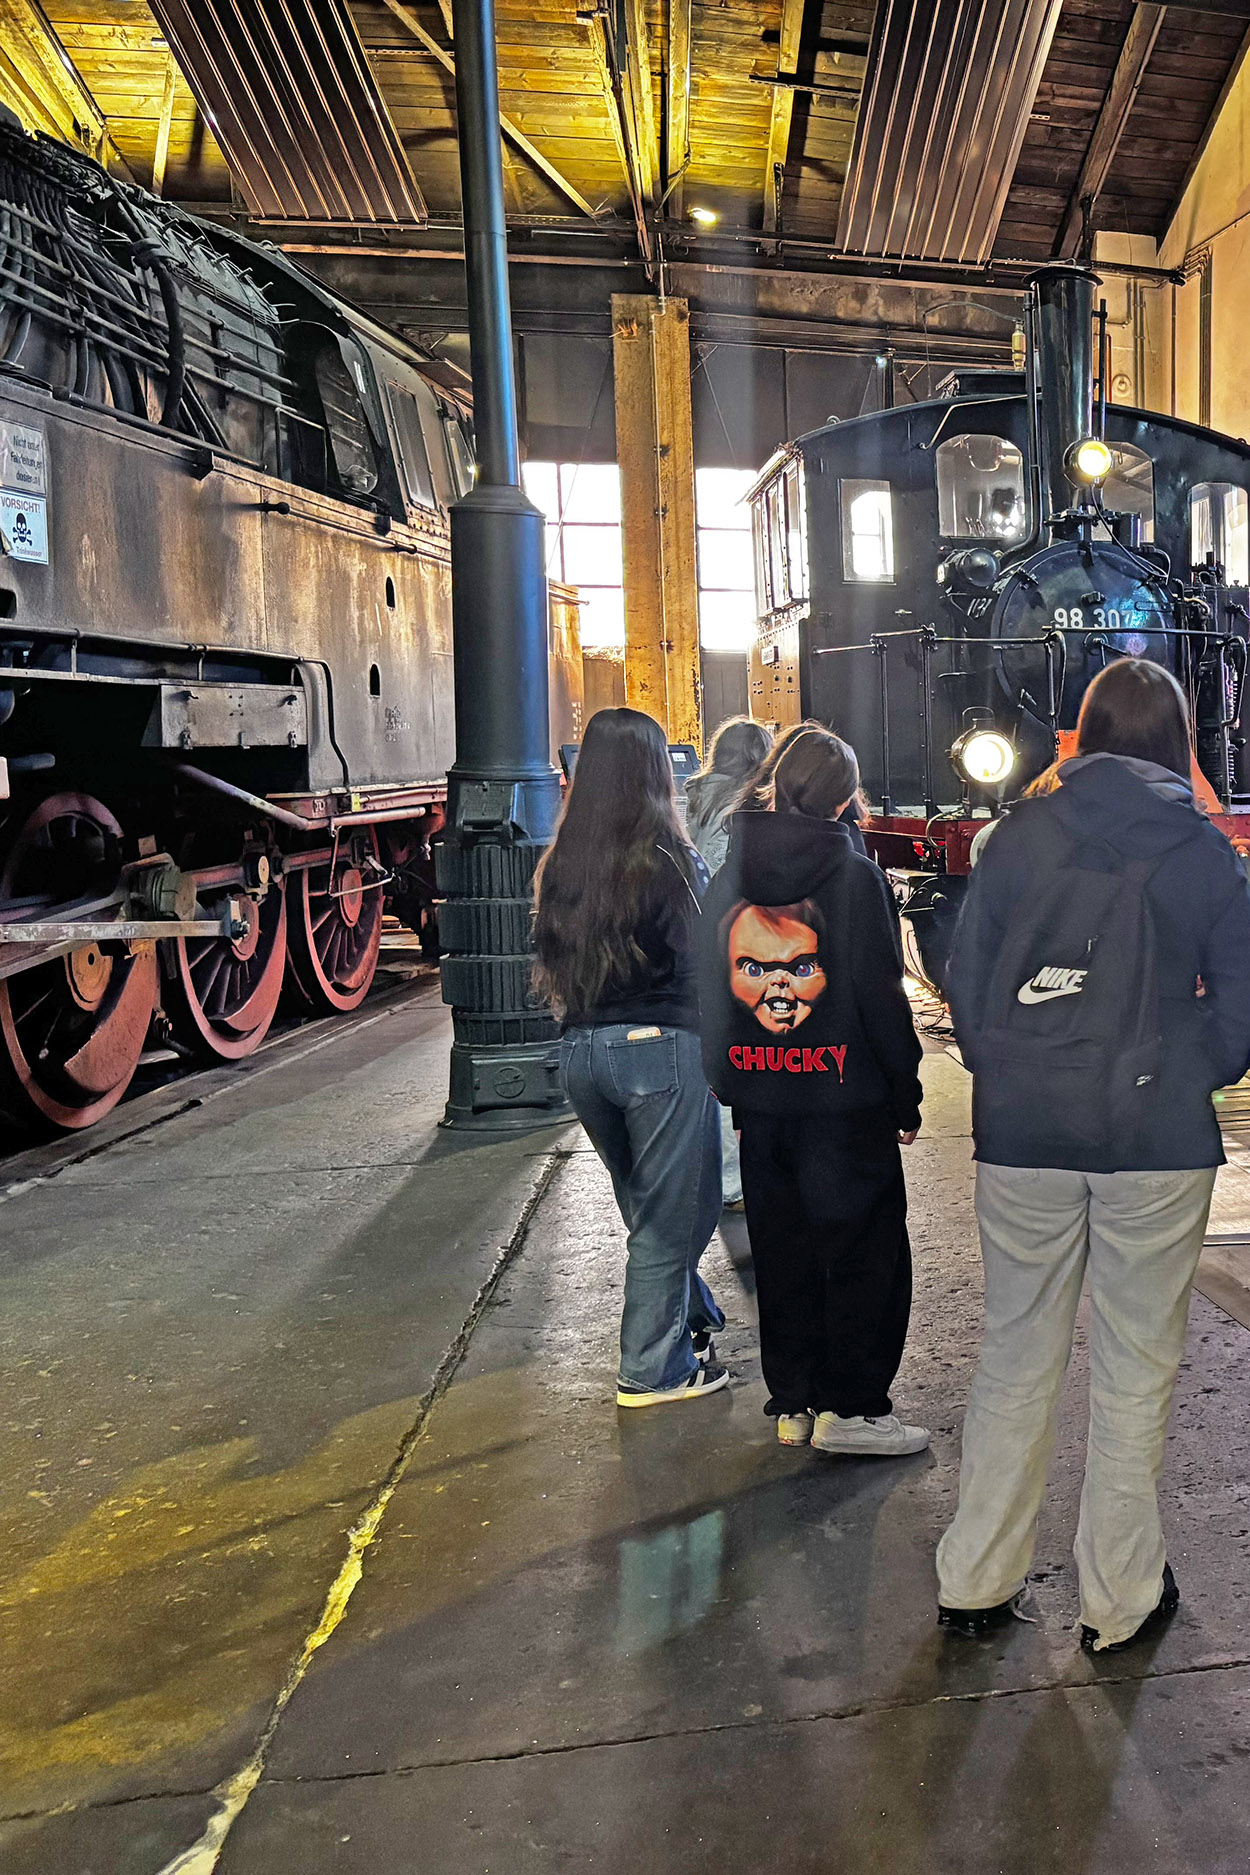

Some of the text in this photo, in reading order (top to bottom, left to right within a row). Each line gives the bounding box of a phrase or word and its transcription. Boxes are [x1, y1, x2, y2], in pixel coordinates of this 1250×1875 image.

[1, 496, 41, 514] VORSICHT!
[1054, 607, 1133, 629] 98 307
[1031, 966, 1089, 991] NIKE
[728, 1044, 848, 1084] CHUCKY
